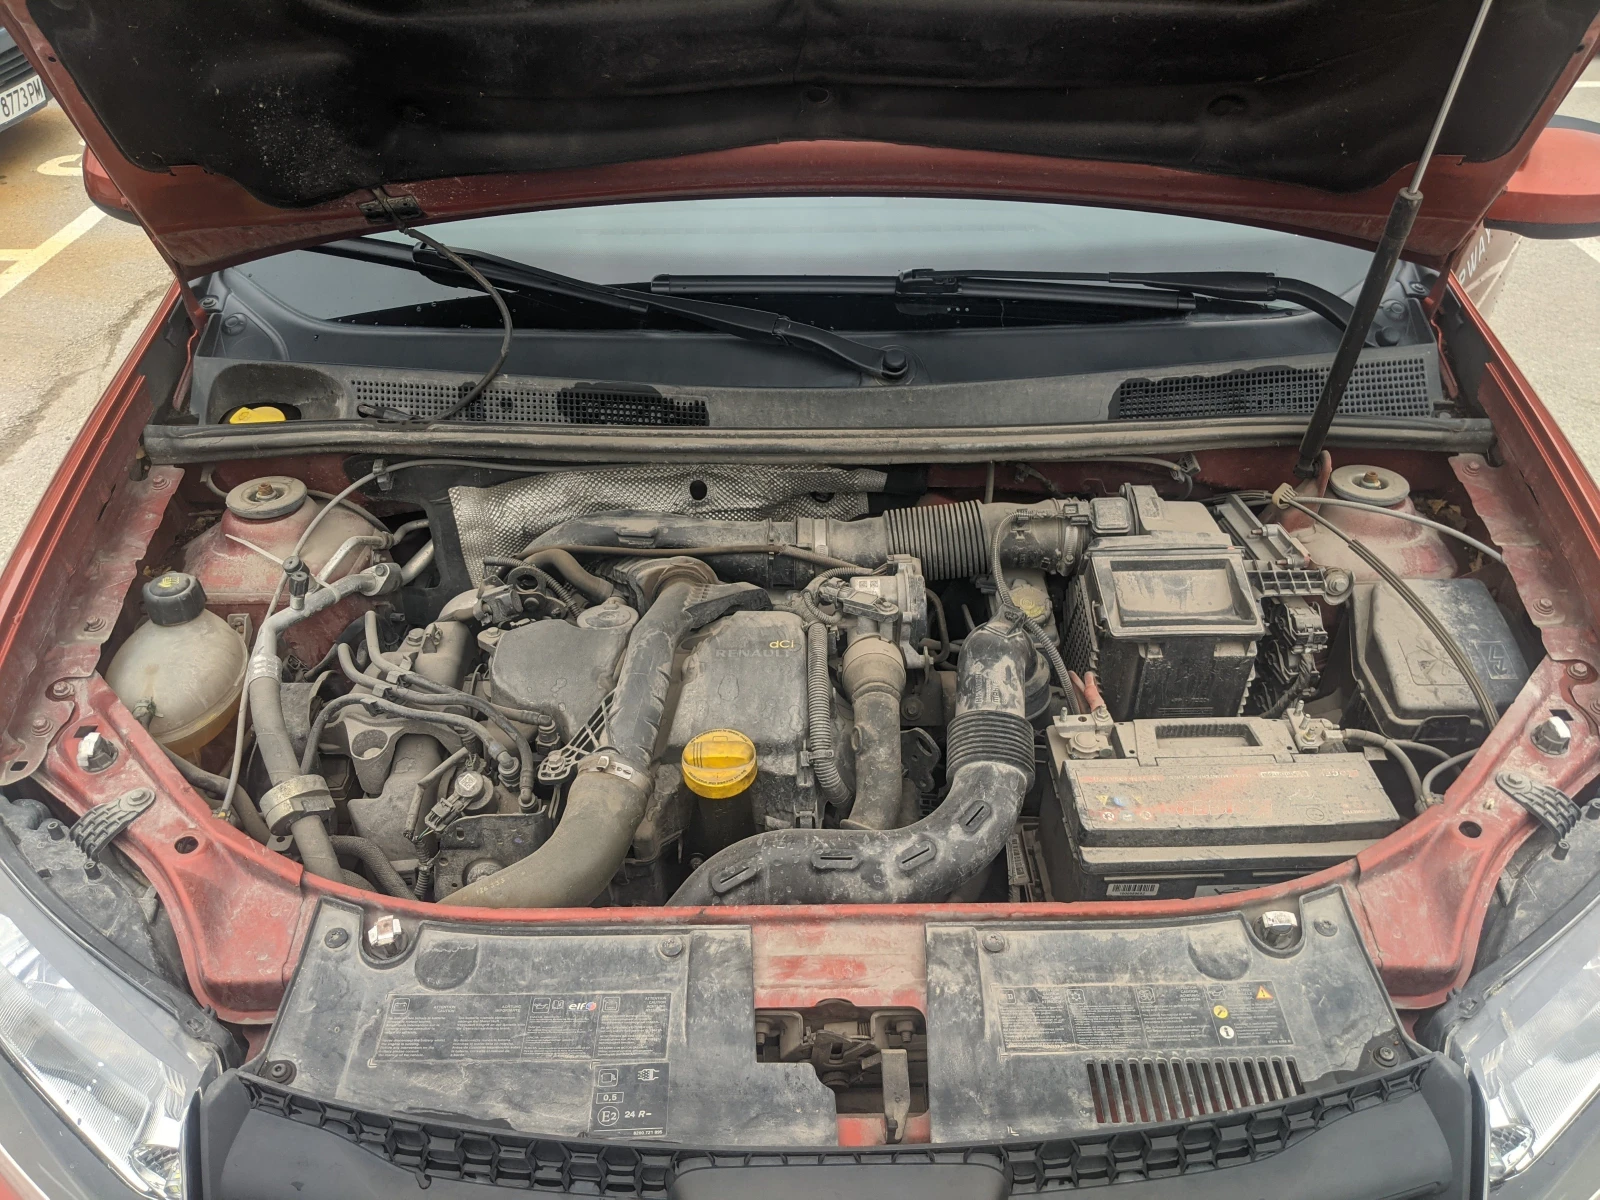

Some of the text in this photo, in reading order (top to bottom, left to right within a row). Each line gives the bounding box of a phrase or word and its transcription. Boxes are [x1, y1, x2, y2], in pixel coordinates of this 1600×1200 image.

[769, 640, 794, 649] dCi
[715, 648, 790, 658] RENAULT
[568, 1002, 586, 1010] elf
[603, 1093, 617, 1102] 0,5
[601, 1110, 617, 1123] E2
[624, 1110, 636, 1118] 24
